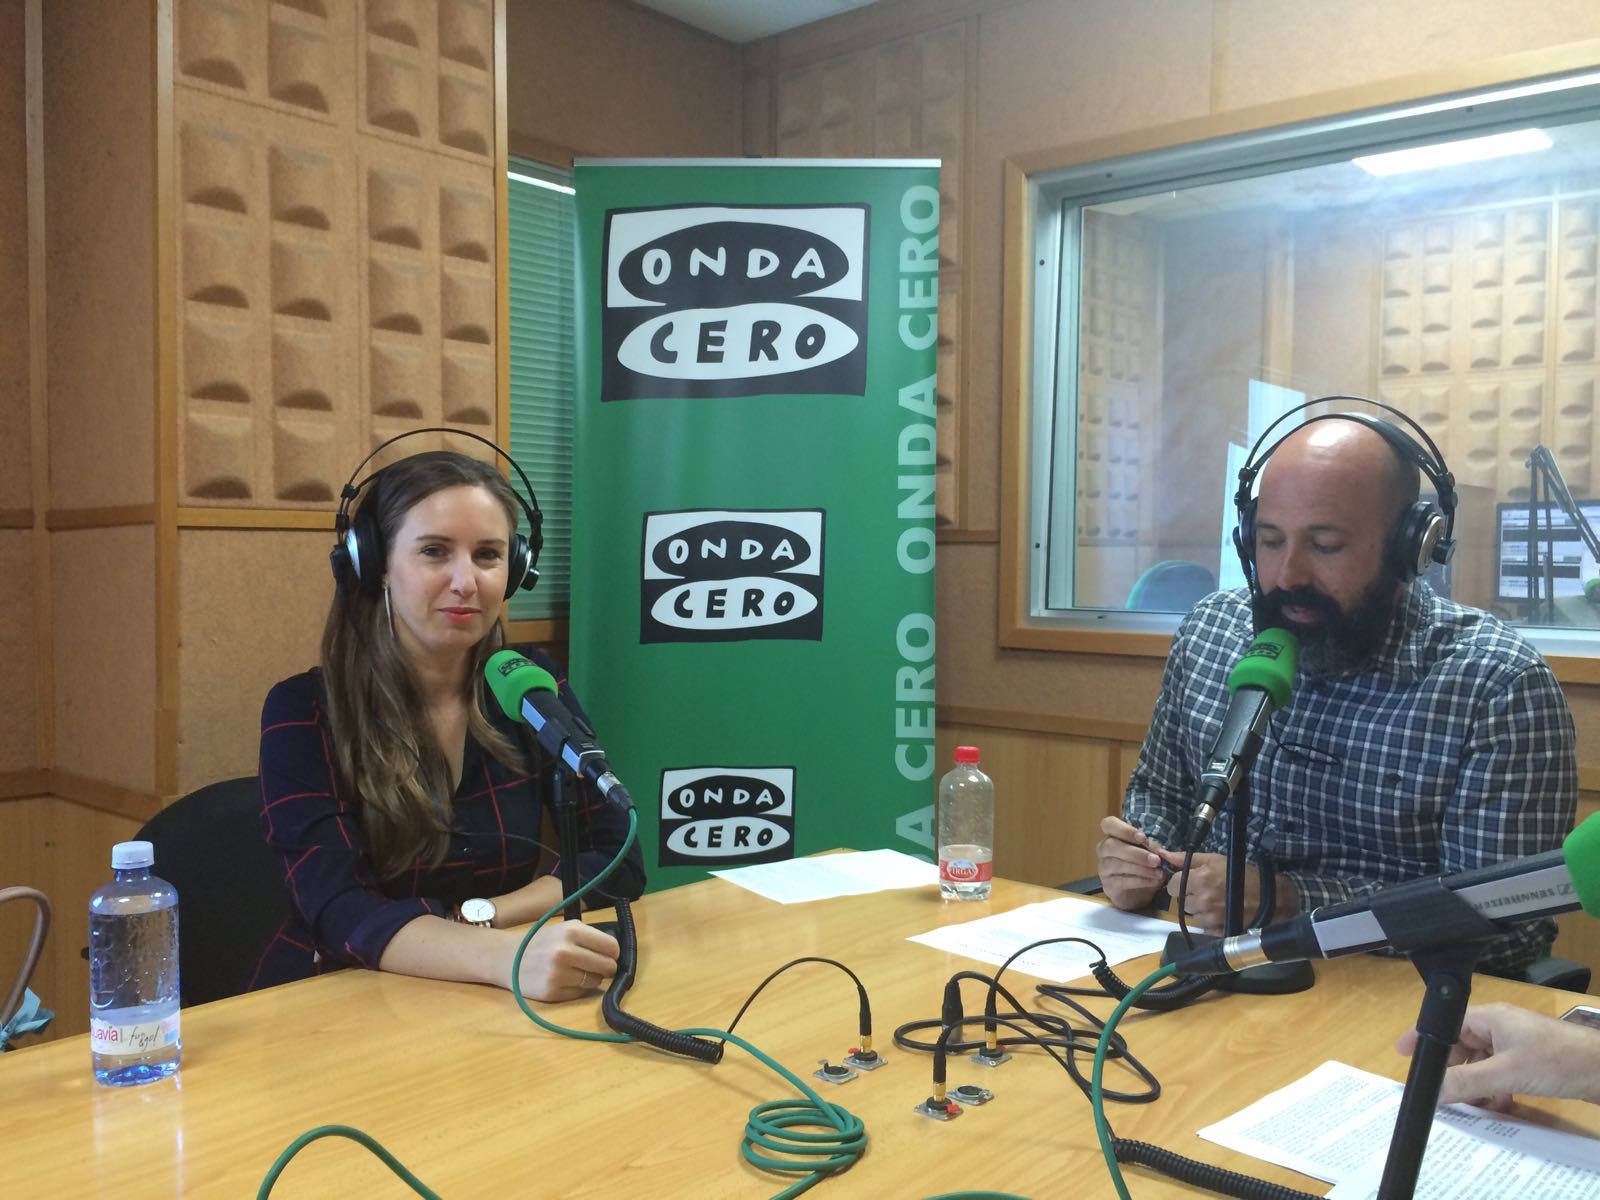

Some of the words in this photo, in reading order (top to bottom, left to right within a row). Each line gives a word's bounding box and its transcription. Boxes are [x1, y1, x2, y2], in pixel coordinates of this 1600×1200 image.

[642, 247, 825, 285] ONDA
[899, 185, 940, 350] CERO
[650, 319, 827, 365] CERO
[897, 374, 937, 574] ONDA
[668, 537, 796, 565] ONDA
[673, 588, 796, 618] CERO
[895, 614, 936, 781] CERO
[679, 787, 774, 808] ONDA
[683, 825, 774, 849] CERO
[895, 805, 935, 864] A
